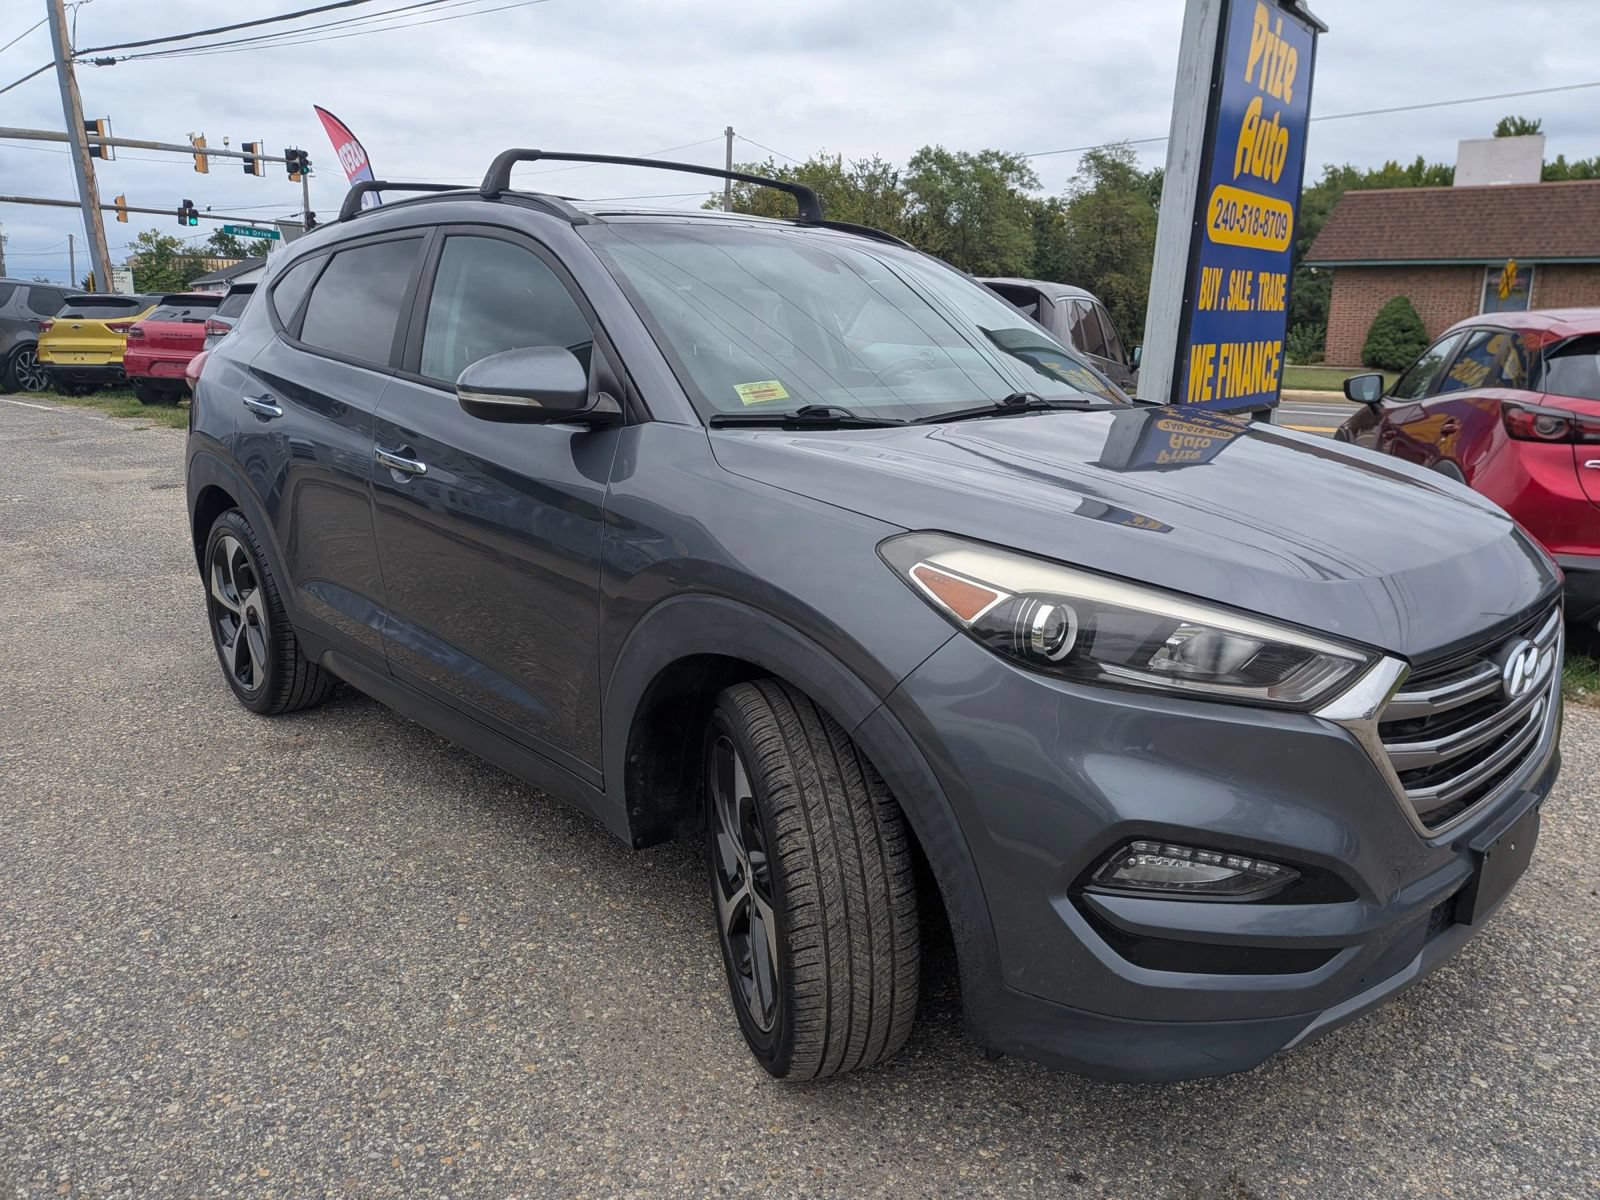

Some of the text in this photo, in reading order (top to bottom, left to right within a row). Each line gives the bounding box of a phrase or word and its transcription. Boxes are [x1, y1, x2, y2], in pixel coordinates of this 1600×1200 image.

[1244, 1, 1297, 105] Prize
[1233, 96, 1289, 185] Auto
[233, 227, 272, 238] Pika Drive
[1213, 198, 1288, 240] 240-518-8709
[1198, 266, 1223, 311] BUY
[1227, 269, 1252, 311] SALE
[1257, 272, 1287, 311] TRADE
[1187, 340, 1281, 403] WE FINANCE
